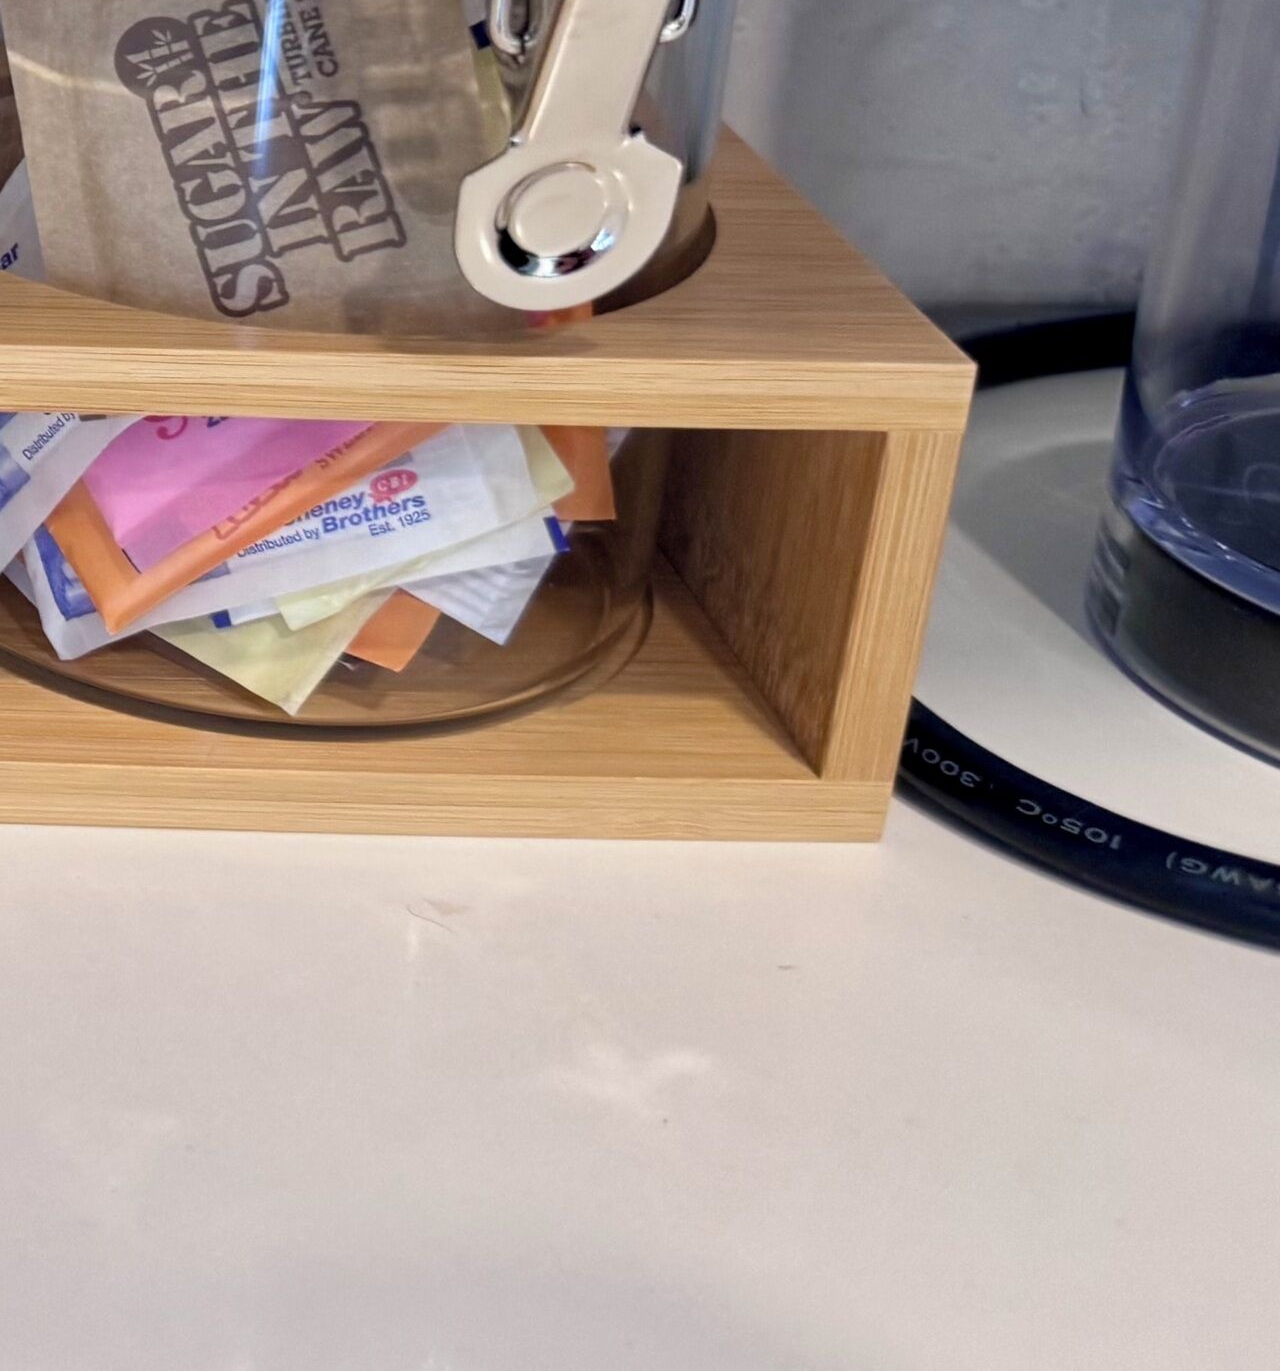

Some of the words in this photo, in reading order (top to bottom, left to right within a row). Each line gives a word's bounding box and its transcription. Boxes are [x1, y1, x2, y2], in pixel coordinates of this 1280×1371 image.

[299, 7, 338, 77] CANE
[148, 66, 287, 316] SUGAR
[289, 100, 404, 260] RAW
[247, 168, 330, 256] IN
[22, 417, 65, 461] Distributed
[304, 527, 320, 541] by
[322, 493, 427, 534] Brothers
[368, 523, 396, 537] Est.
[398, 507, 432, 529] 1925
